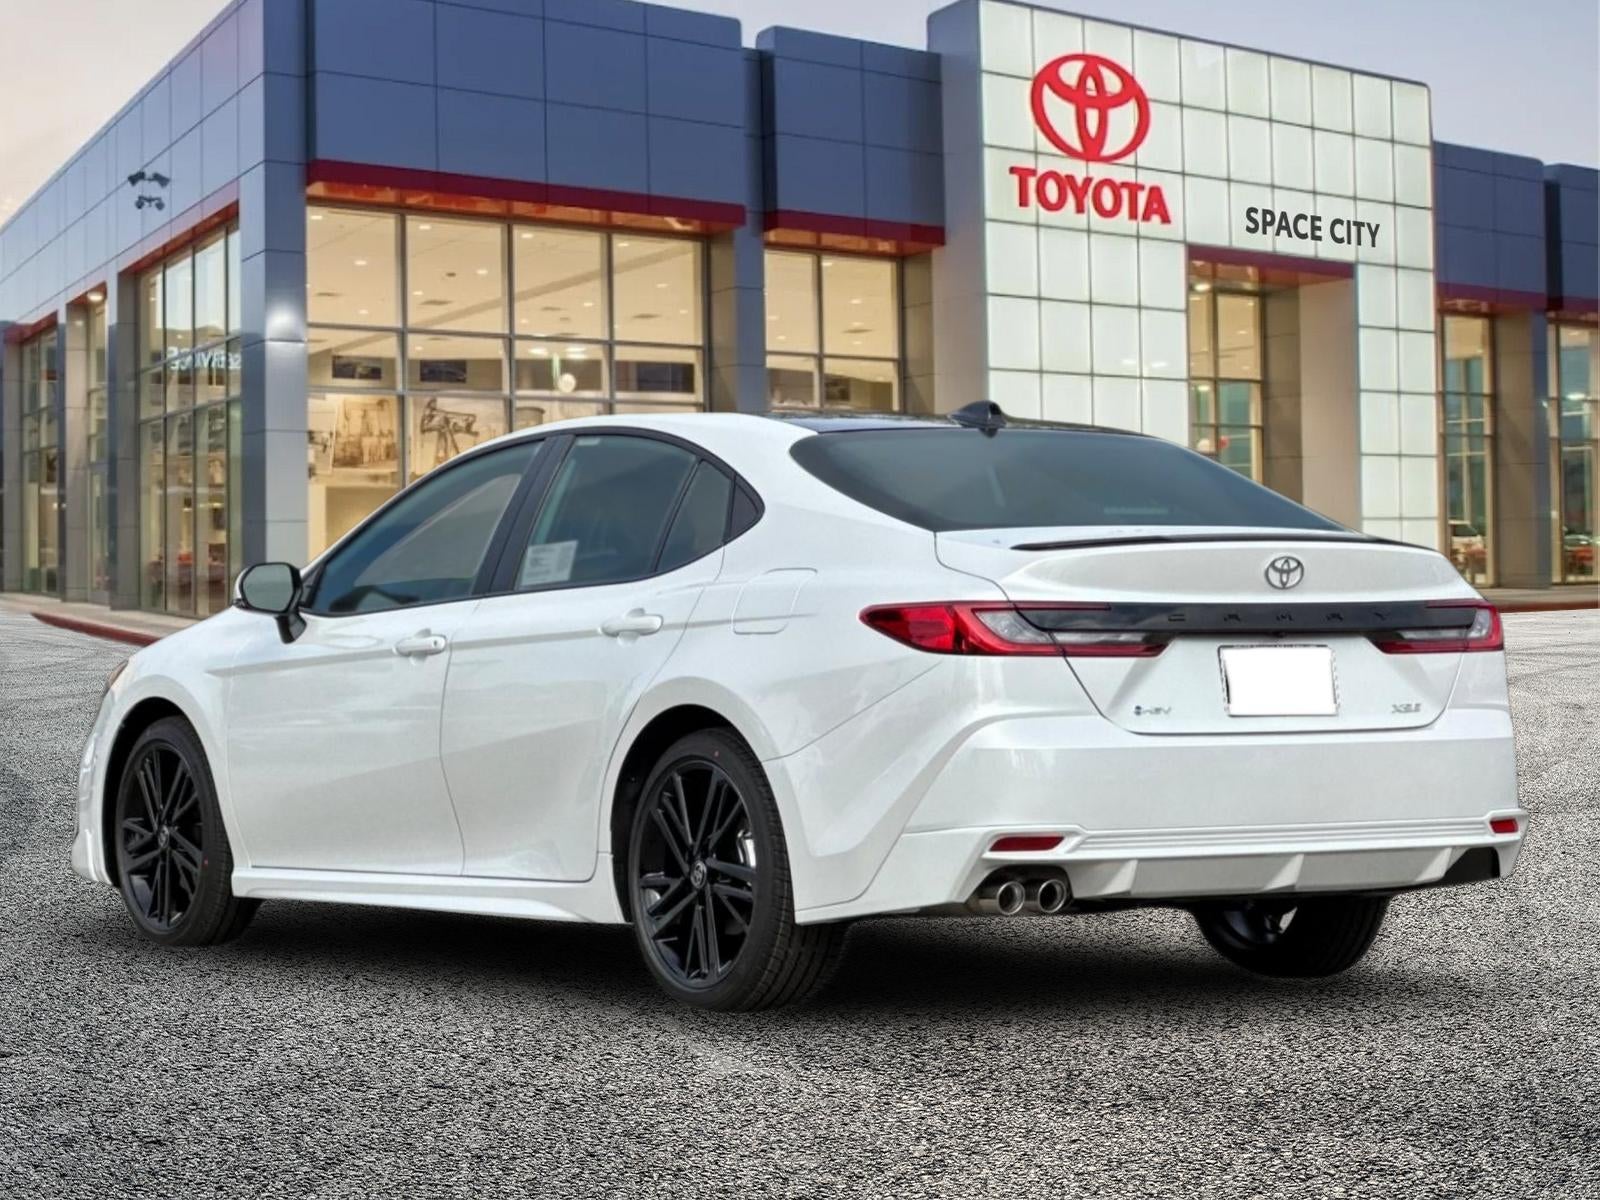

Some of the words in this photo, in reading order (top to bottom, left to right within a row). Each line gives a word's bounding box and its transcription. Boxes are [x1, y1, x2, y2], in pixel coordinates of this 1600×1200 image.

[1009, 166, 1171, 224] TOYOTA
[1245, 206, 1323, 242] SPACE
[1329, 218, 1381, 248] CITY
